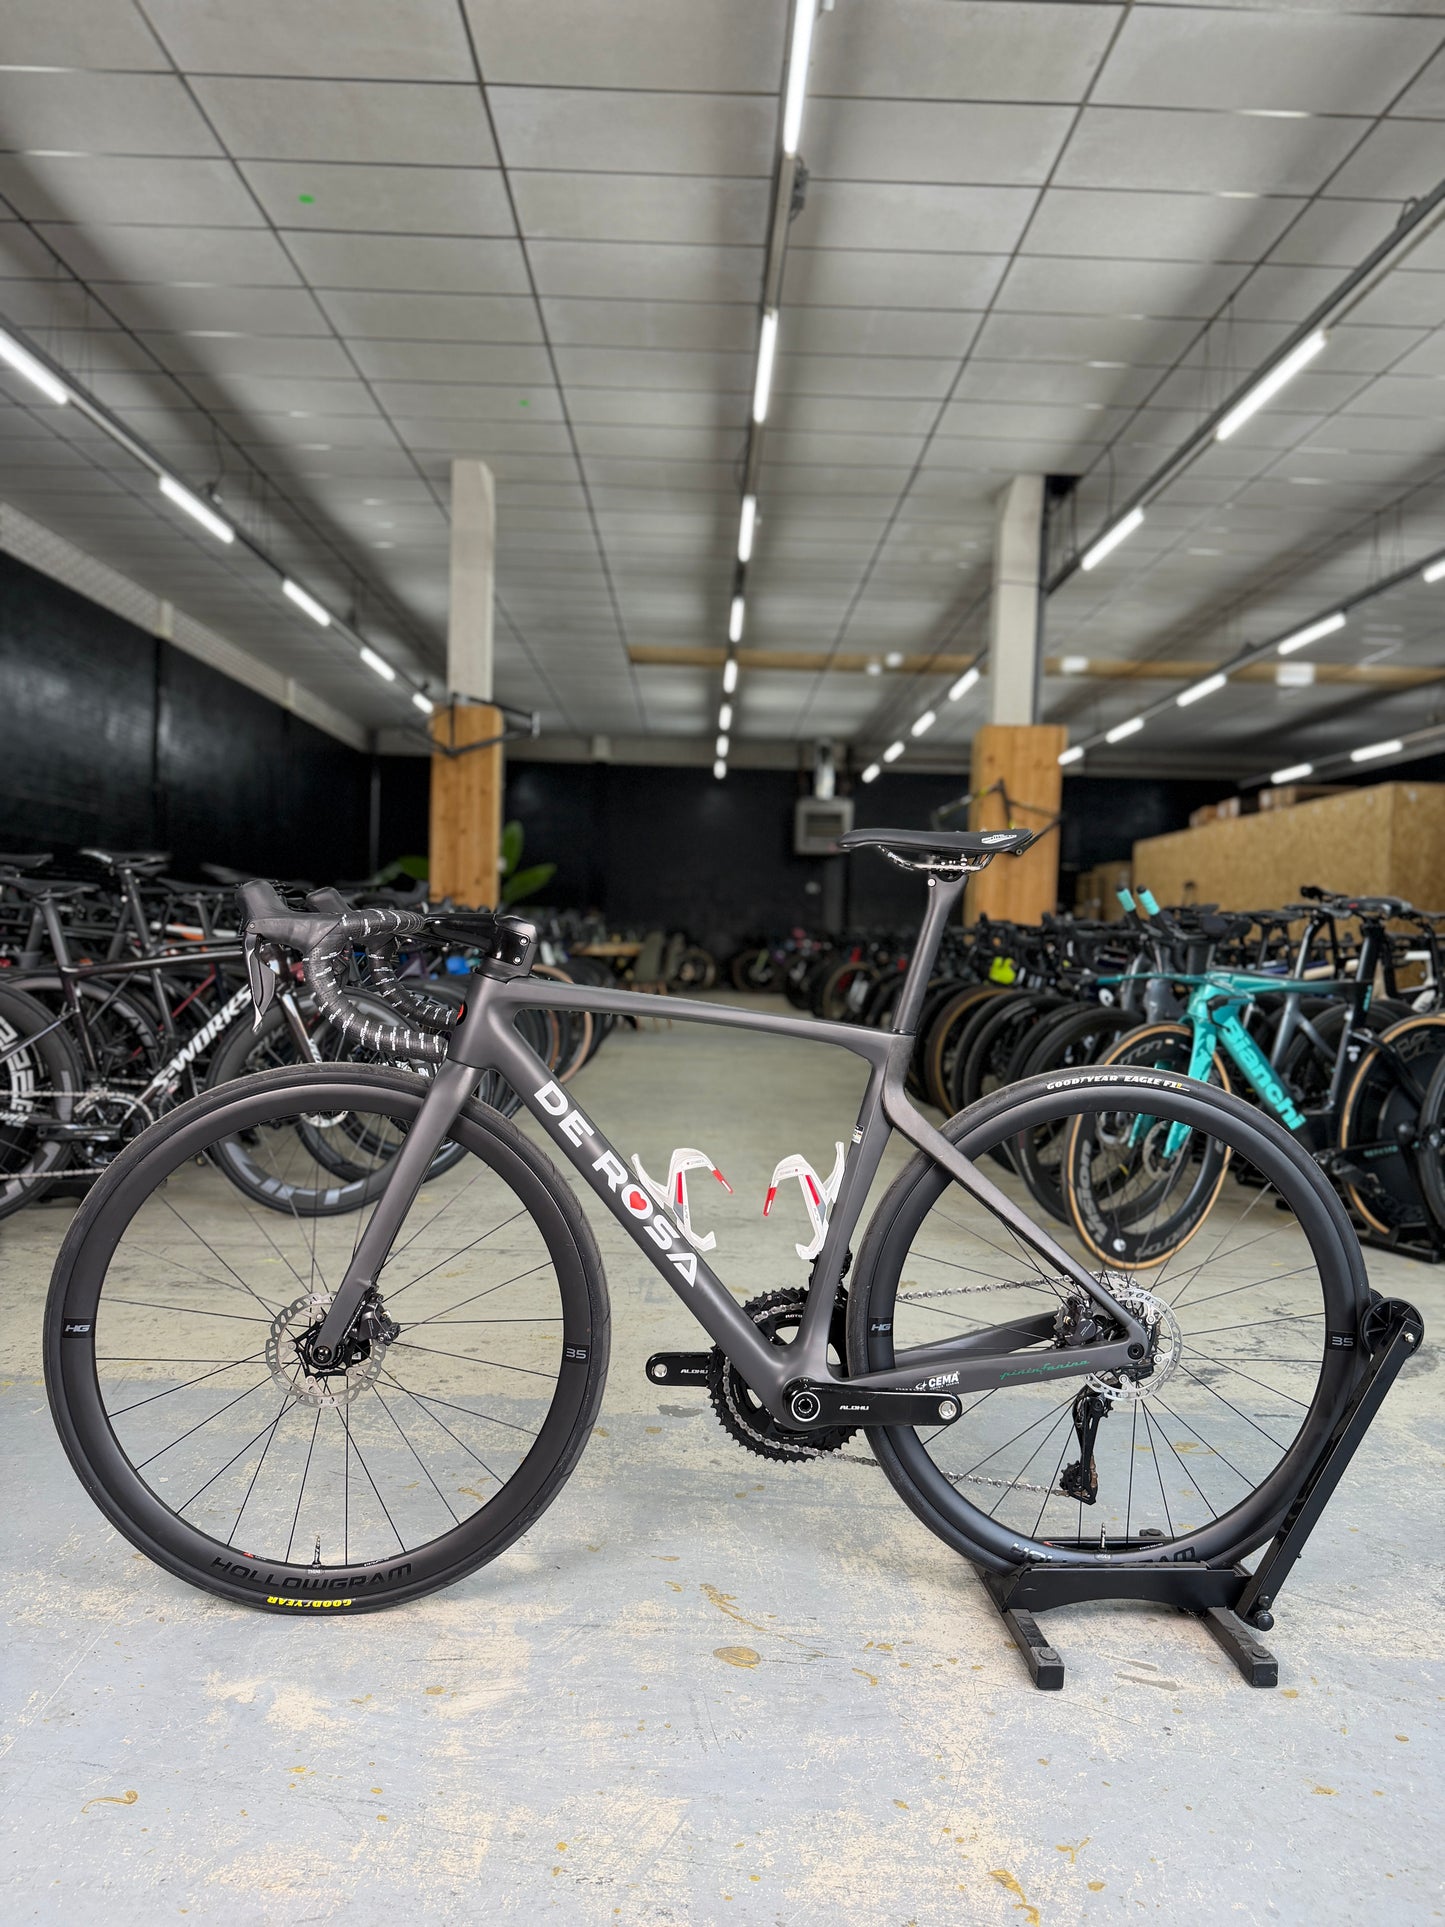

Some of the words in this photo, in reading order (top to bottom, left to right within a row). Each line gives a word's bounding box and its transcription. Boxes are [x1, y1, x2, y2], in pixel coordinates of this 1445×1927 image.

[152, 984, 252, 1096] S-WORKS
[1218, 1016, 1306, 1130] Bianchi
[1046, 1075, 1119, 1090] GOODYEAR
[1123, 1075, 1163, 1086] EAGLE
[534, 1080, 594, 1148] DE
[592, 1150, 697, 1287] ROSA
[65, 1324, 90, 1333] HG
[871, 1323, 892, 1332] HG
[1331, 1335, 1354, 1347] 35
[565, 1347, 587, 1359] 35
[928, 1372, 959, 1387] CEMA
[211, 1557, 412, 1590] HOLLOWGRAM
[266, 1596, 352, 1607] GOODYEAR
